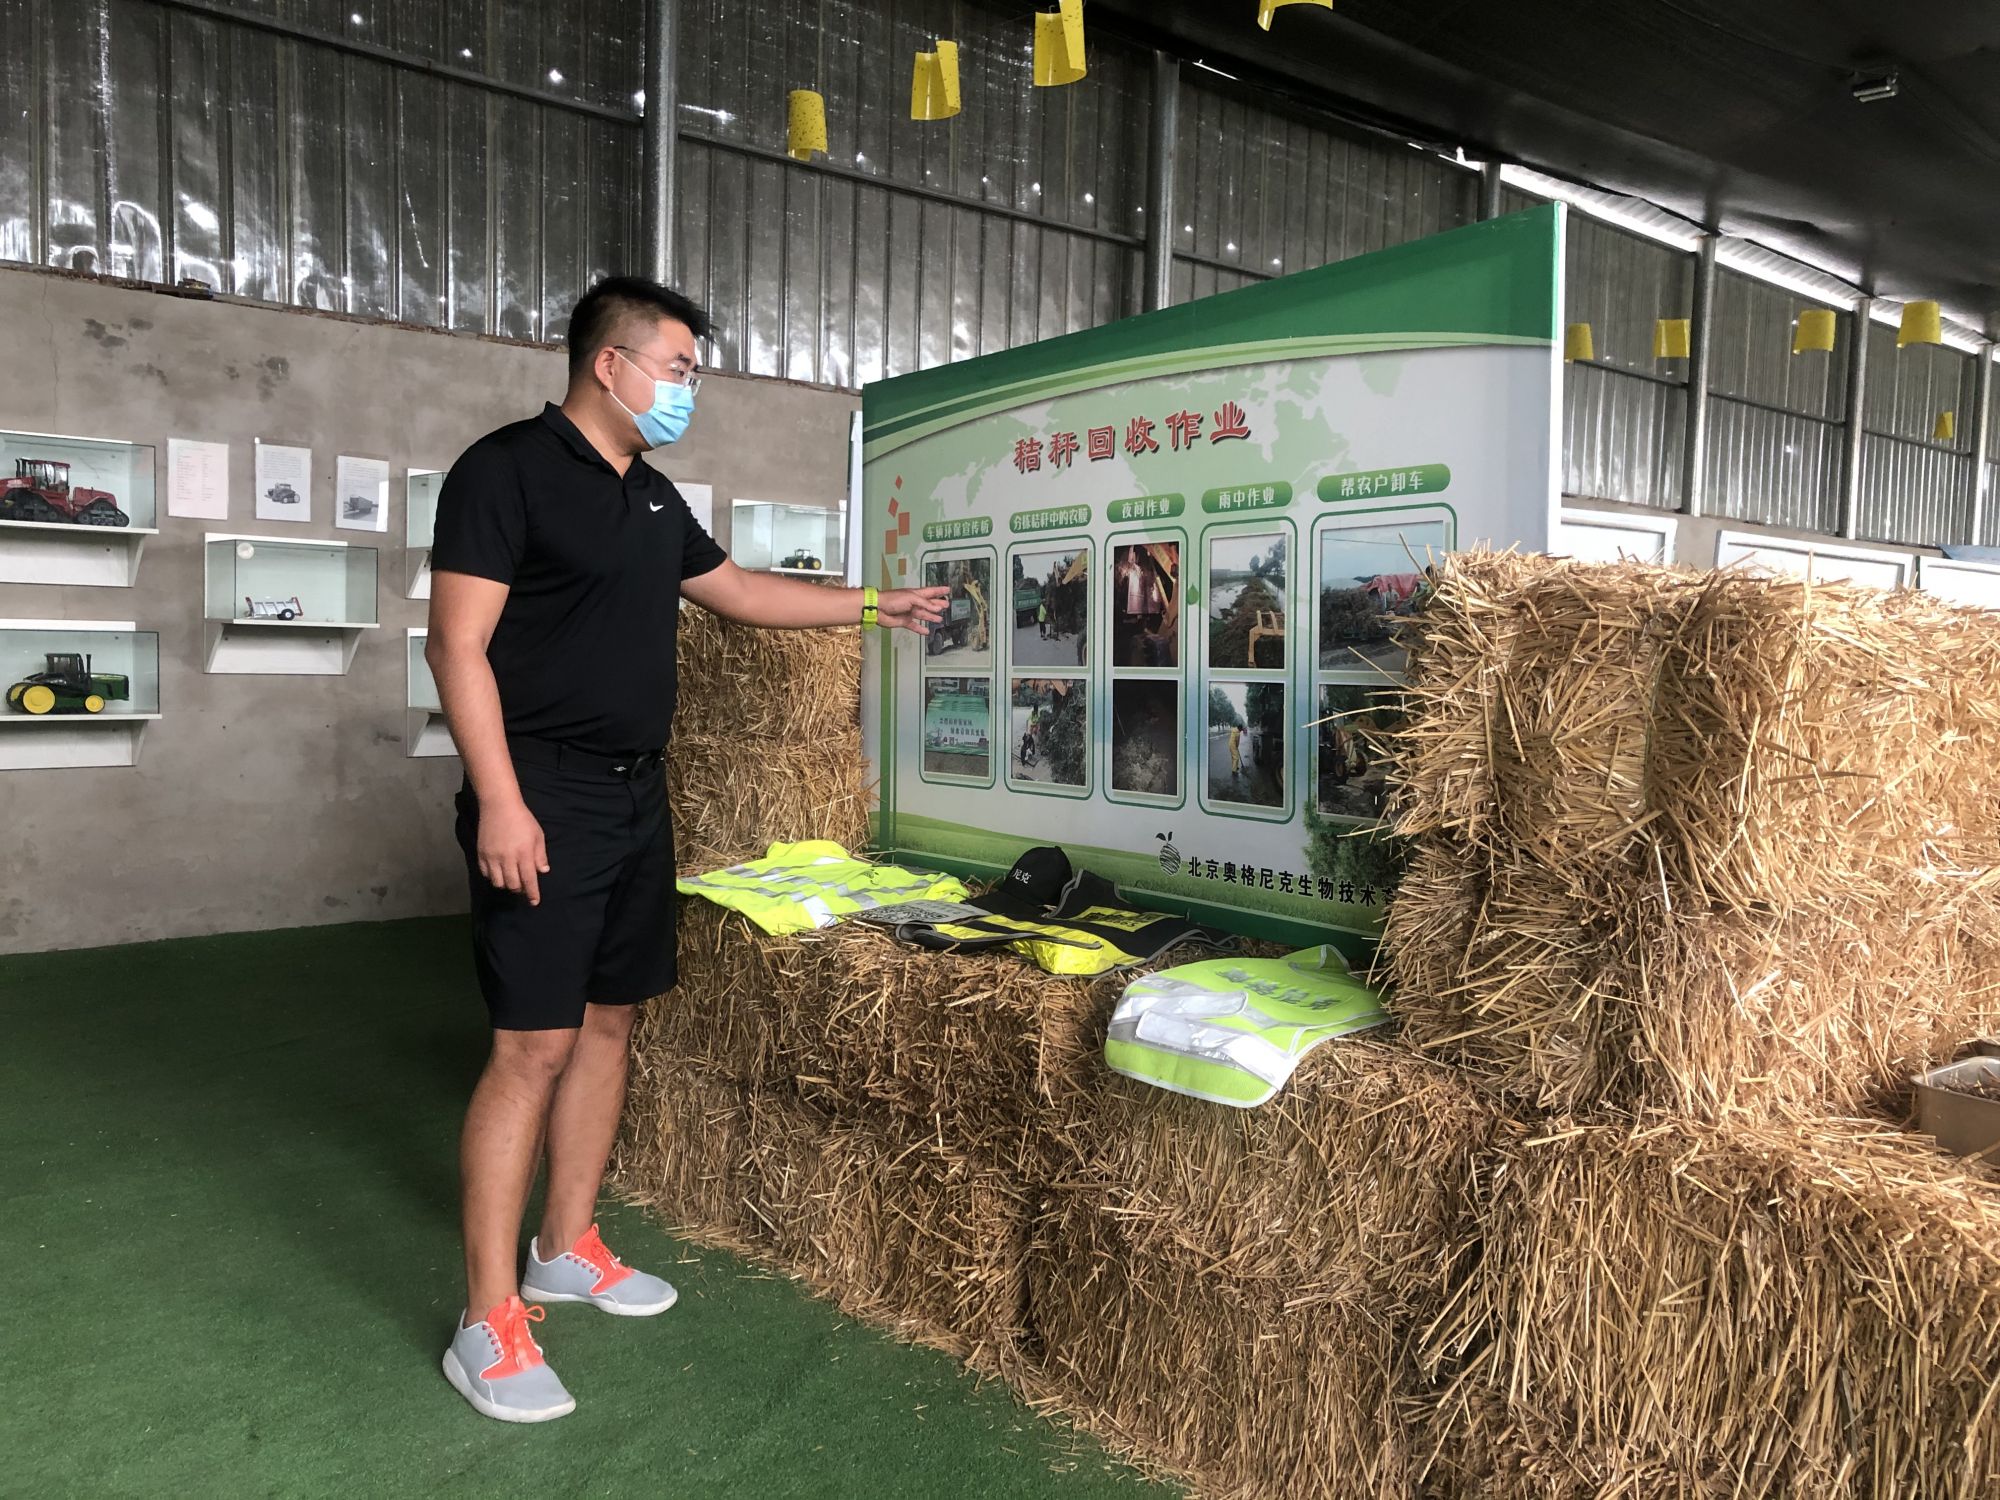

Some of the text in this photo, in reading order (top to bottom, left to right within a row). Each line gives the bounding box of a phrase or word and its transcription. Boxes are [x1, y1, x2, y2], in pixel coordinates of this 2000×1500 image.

[1013, 400, 1250, 474] 秸秆回收作业
[1340, 470, 1424, 497] 帮农户卸车
[1122, 497, 1170, 519] 夜间作业
[1219, 486, 1275, 510] 雨中作业
